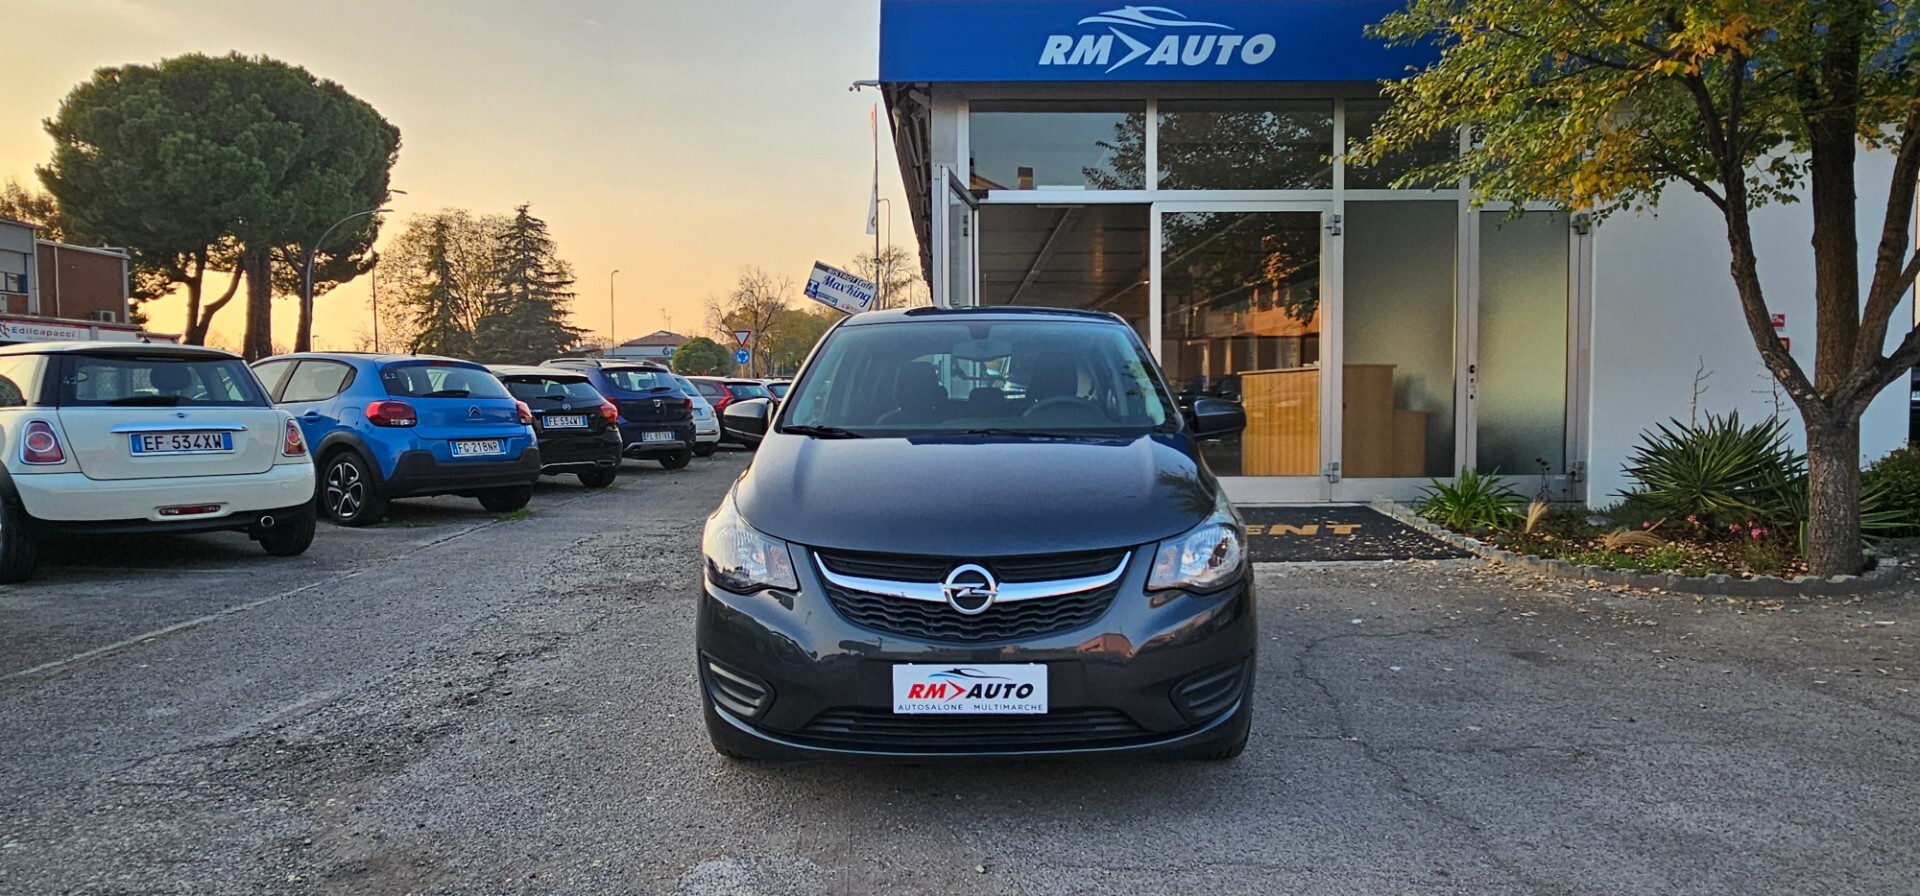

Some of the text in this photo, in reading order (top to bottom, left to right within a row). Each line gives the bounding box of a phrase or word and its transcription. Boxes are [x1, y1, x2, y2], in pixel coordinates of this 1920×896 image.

[1144, 33, 1277, 66] AUTO
[827, 268, 858, 283] BISTROT
[11, 326, 75, 338] Edilcapacci
[143, 435, 164, 451] EF
[171, 434, 222, 450] 534XW
[457, 441, 498, 453] FG 218NR
[965, 683, 1034, 699] AUTO
[898, 703, 1043, 711] AUTOSALONE MULTIMARCHE
